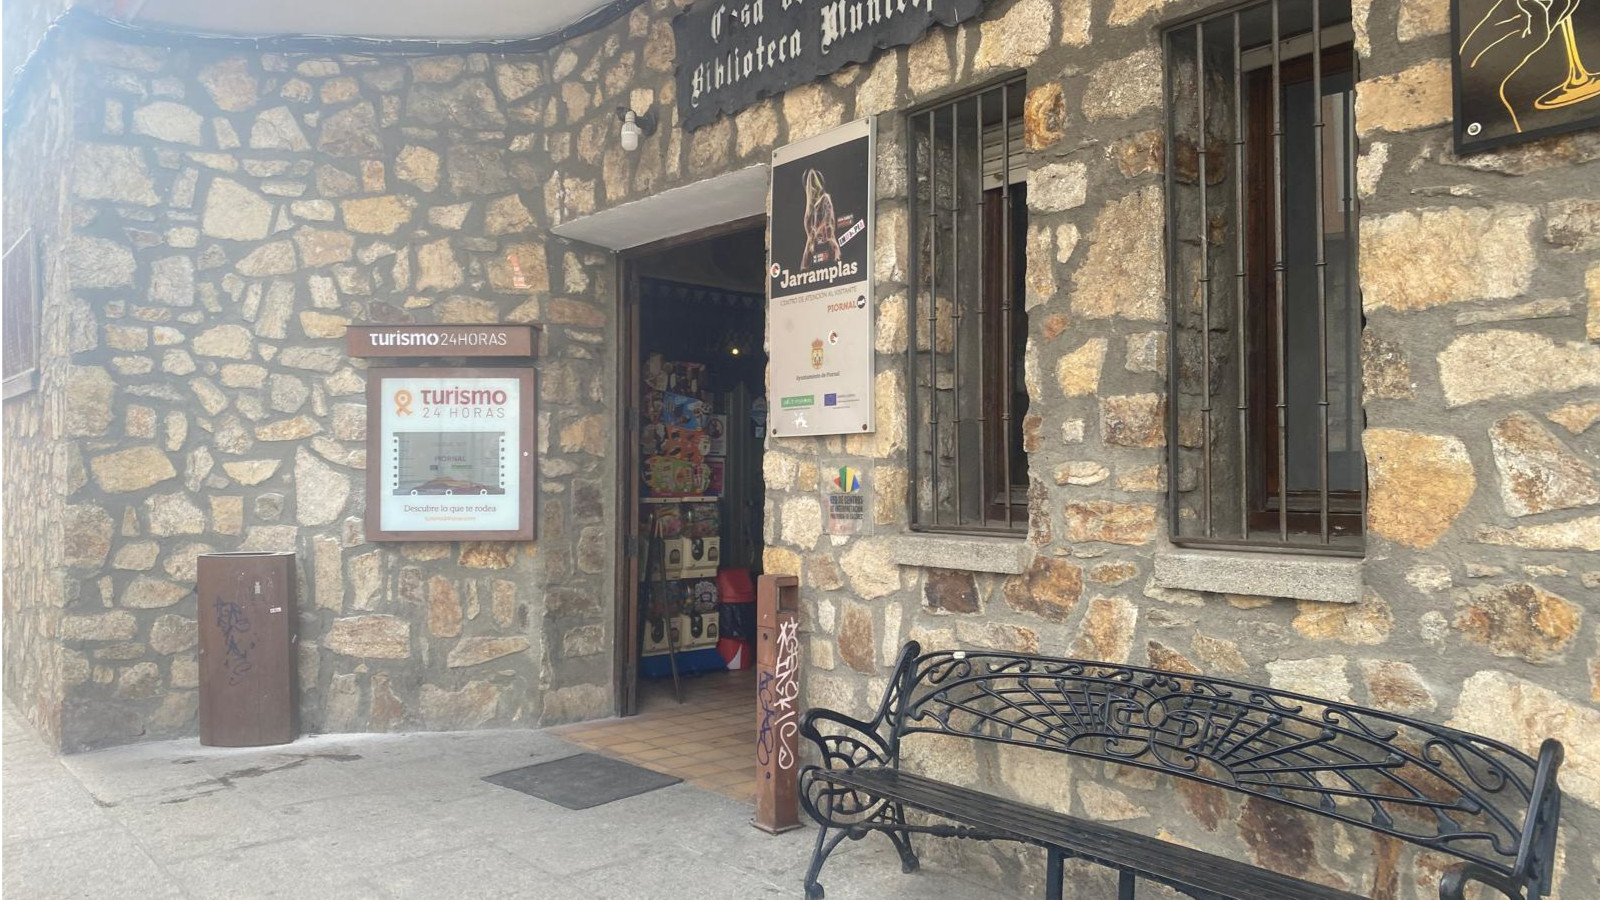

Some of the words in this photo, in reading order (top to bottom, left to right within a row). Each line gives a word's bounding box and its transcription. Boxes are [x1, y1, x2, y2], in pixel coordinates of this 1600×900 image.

[711, 0, 764, 44] Csa
[691, 29, 802, 108] Biblioteca
[780, 260, 858, 289] Jarramplas
[827, 300, 857, 312] PIORNAL
[421, 387, 507, 405] turismo
[423, 407, 440, 419] 24
[450, 407, 505, 419] HORAS
[404, 504, 439, 513] Descubre
[440, 504, 448, 513] lo
[449, 506, 464, 514] que
[466, 505, 473, 513] te
[474, 504, 497, 513] rodea
